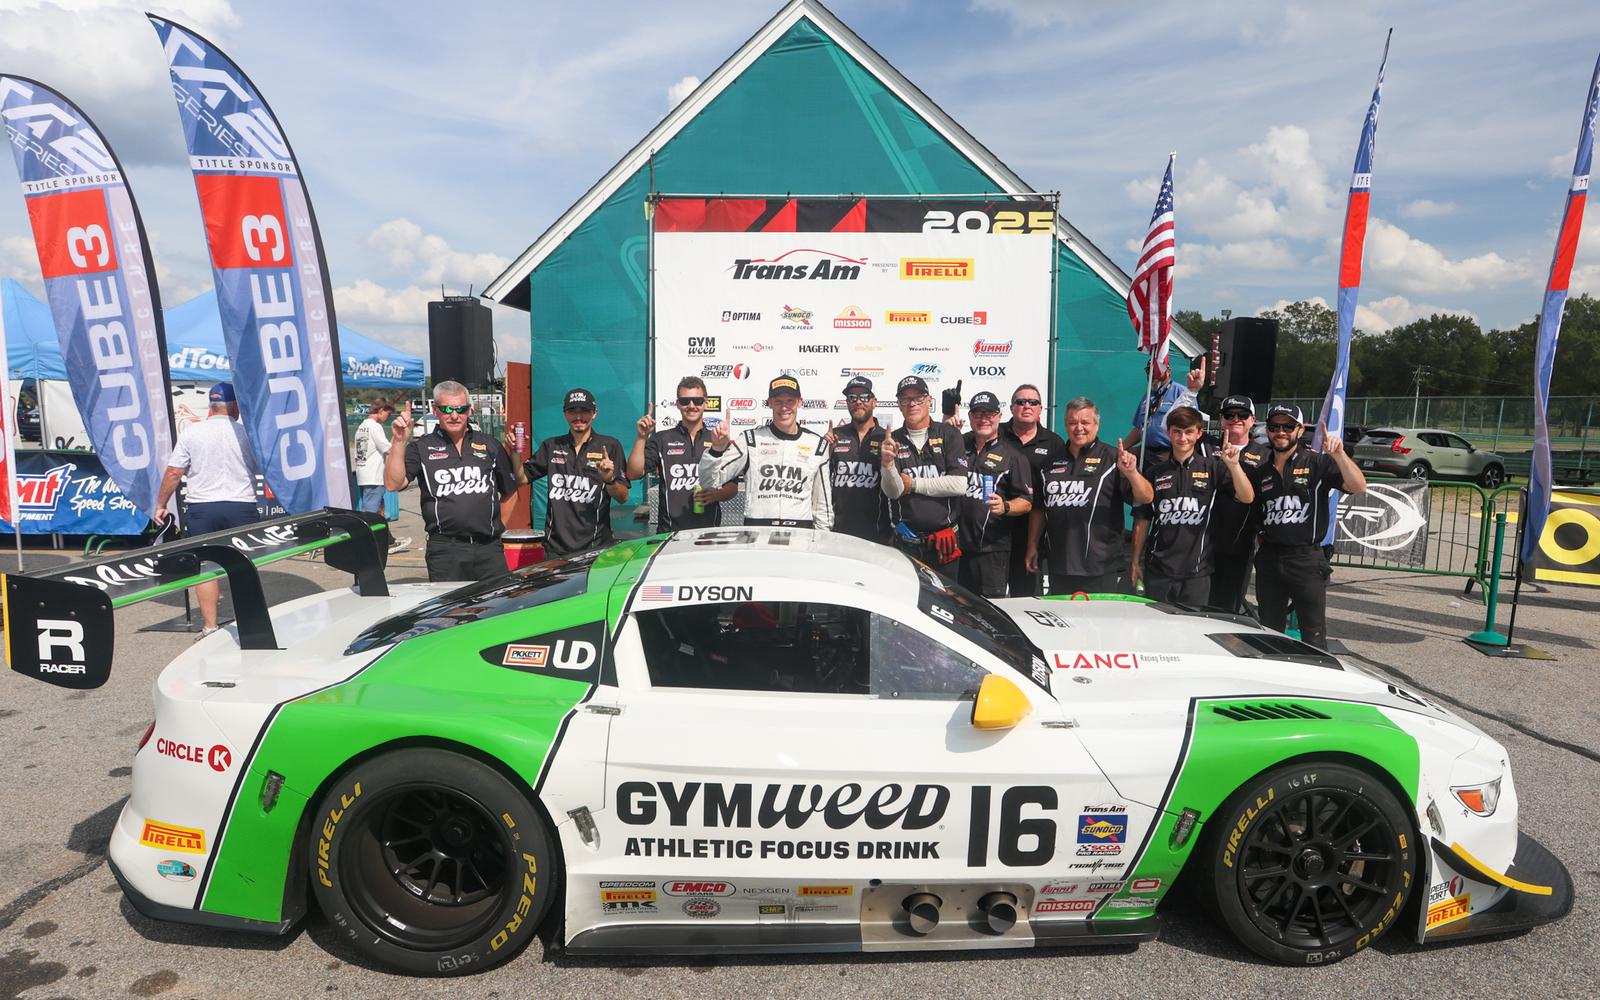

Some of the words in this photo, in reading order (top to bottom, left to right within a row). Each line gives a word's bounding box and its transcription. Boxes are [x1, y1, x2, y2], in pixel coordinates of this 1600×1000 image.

[173, 82, 250, 158] SERIES
[5, 124, 75, 178] SERIES
[198, 159, 233, 168] TITLE
[240, 161, 291, 172] SPONSOR
[27, 178, 59, 192] TITLE
[64, 173, 118, 186] SPONSOR
[922, 210, 1054, 234] 2025
[733, 259, 806, 280] Trans
[809, 259, 861, 280] Am
[906, 262, 968, 277] PIRELLI
[732, 312, 761, 321] OPTIMA
[890, 313, 927, 323] PIRELLI
[120, 220, 171, 463] ARCHITECTURE
[296, 216, 347, 471] ARCHITECTURE
[688, 337, 715, 347] GYM
[799, 345, 840, 353] HAGERTY
[347, 357, 404, 380] SpeedTour
[969, 366, 1006, 376] VBOX
[434, 466, 481, 484] GYM
[760, 464, 802, 480] GYM
[837, 461, 873, 476] GYM
[72, 476, 101, 495] The
[436, 475, 489, 497] weed
[551, 473, 590, 490] GYM
[759, 476, 808, 494] weed
[835, 472, 879, 488] weed
[1047, 481, 1085, 495] GYM
[549, 485, 598, 503] weed
[1048, 487, 1092, 507] weed
[69, 496, 106, 517] Speed
[1158, 497, 1199, 512] GYM
[20, 513, 54, 521] PMENT
[1159, 505, 1206, 525] weed
[678, 586, 753, 601] DYSON
[40, 663, 86, 674] RACER
[1054, 653, 1139, 669] LANCI
[1160, 655, 1180, 663] Engines
[157, 738, 203, 763] CIRCLE
[213, 749, 230, 770] K
[1303, 774, 1317, 785] RF
[318, 782, 361, 887] PIRELLI
[967, 786, 1058, 867] 16
[1083, 826, 1121, 834] SUNOCO
[1223, 788, 1274, 868] PIRELLI
[143, 824, 201, 849] PIRELLI
[624, 837, 752, 859] ATHLETIC
[760, 840, 850, 859] FOCUS
[856, 841, 940, 859] DRINK
[672, 883, 727, 892] EMCO
